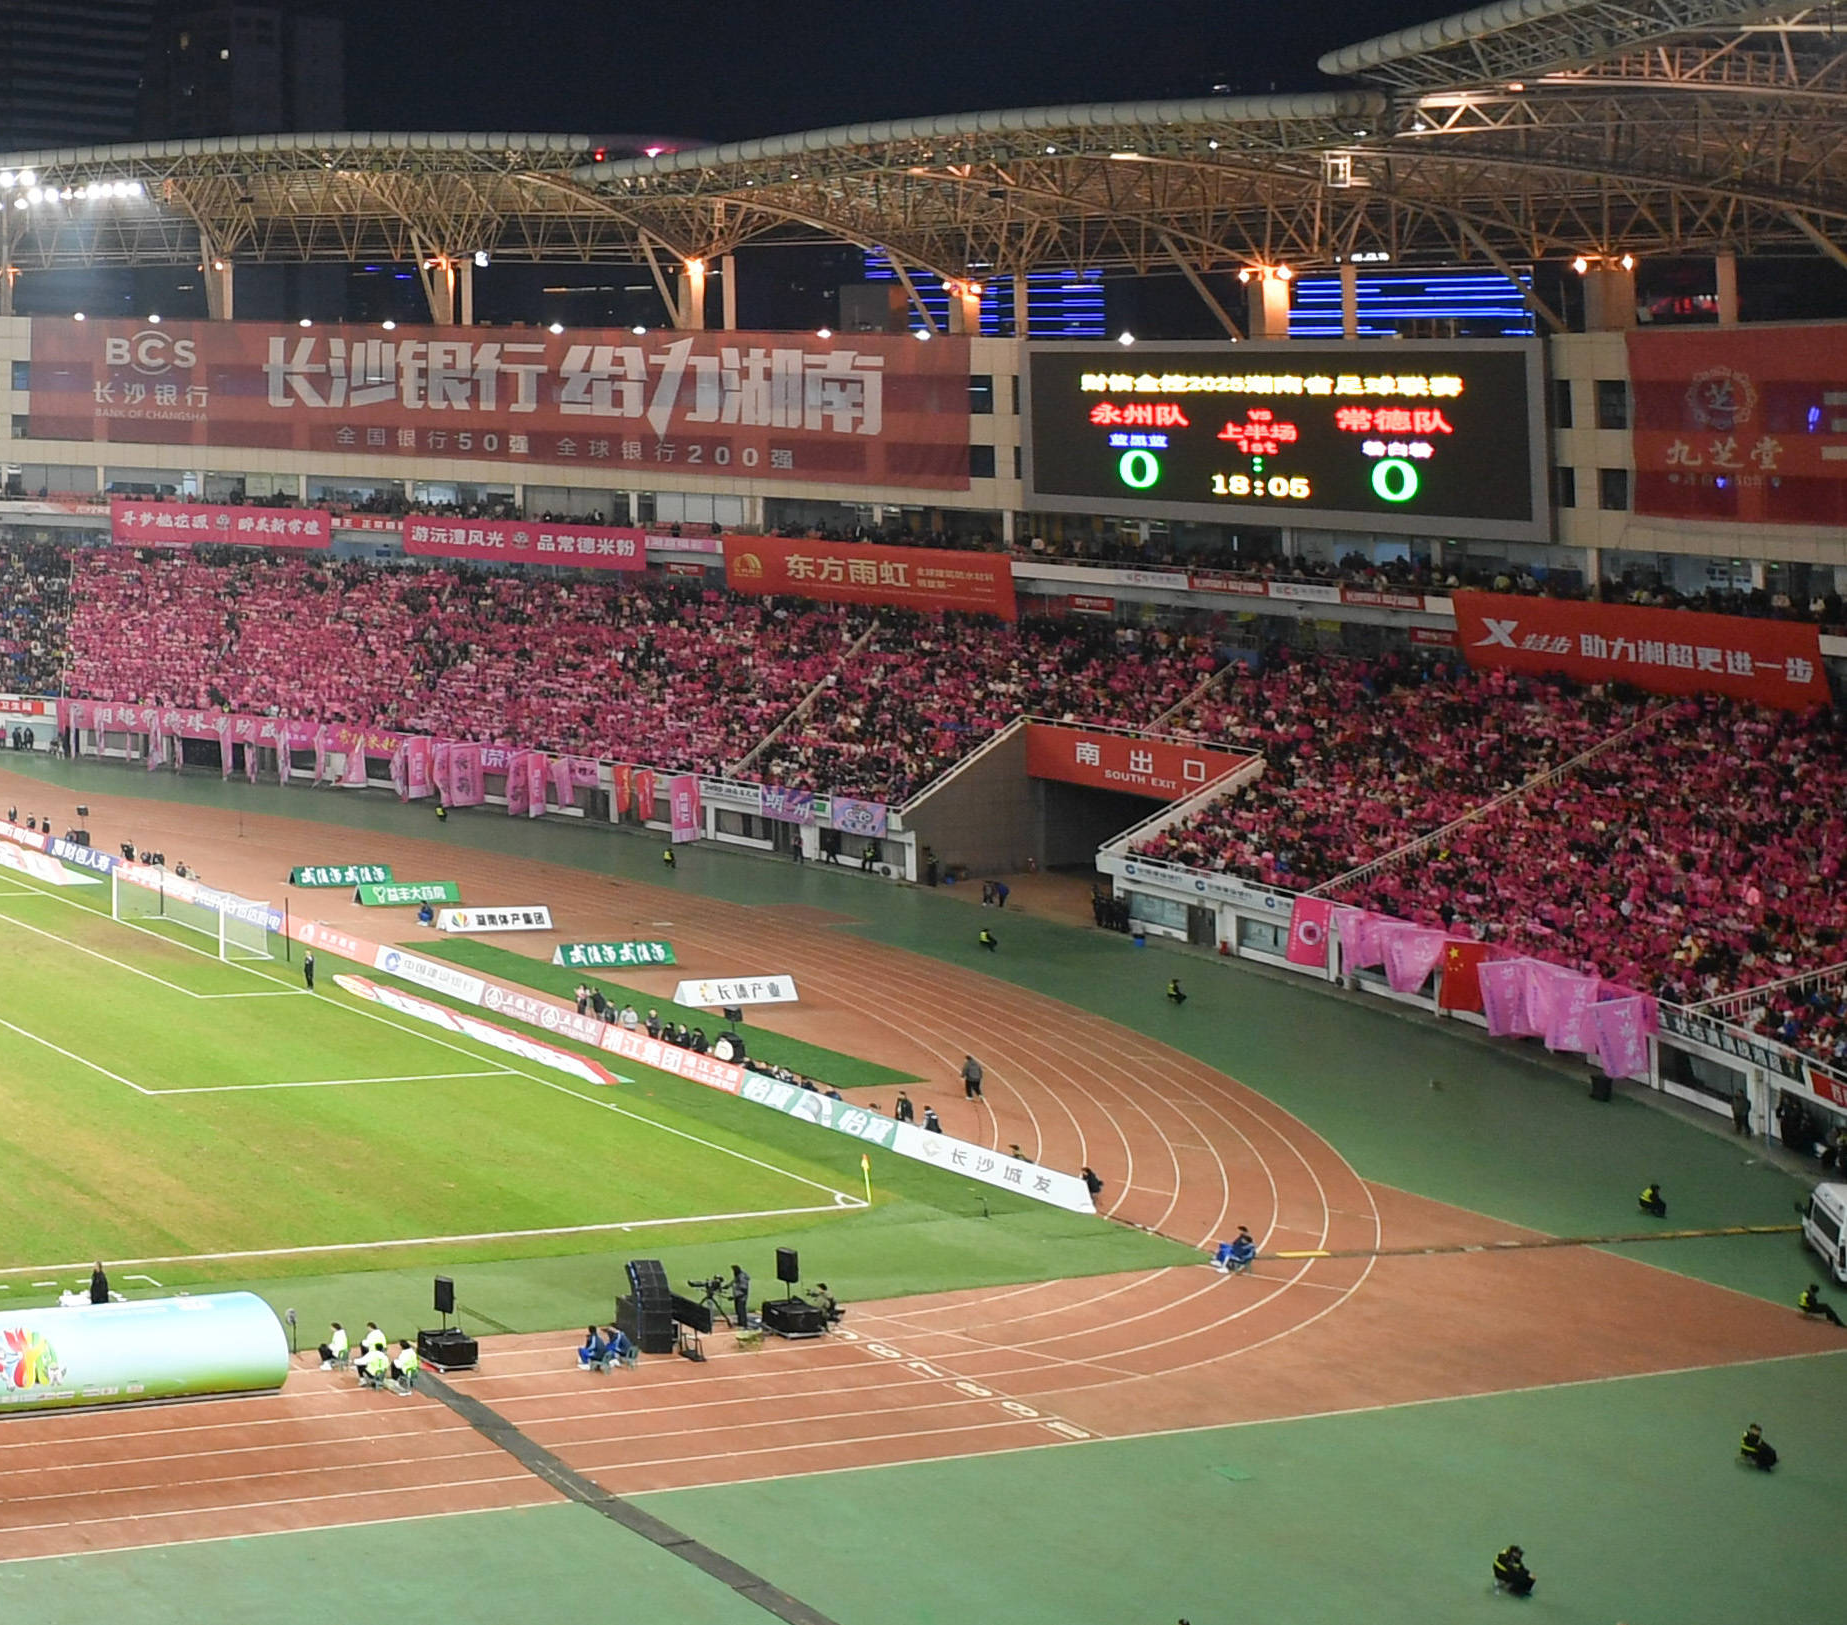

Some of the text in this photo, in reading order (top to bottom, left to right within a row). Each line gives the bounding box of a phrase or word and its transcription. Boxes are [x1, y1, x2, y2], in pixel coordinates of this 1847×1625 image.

[106, 337, 196, 368] BCS
[93, 381, 210, 408] 长沙银行
[263, 336, 884, 442] 长沙银行 给力湖南
[94, 408, 208, 422] BANK OF CHANGSHA
[1089, 401, 1189, 427] 永州队
[1335, 407, 1453, 434] 常德队
[337, 426, 793, 469] 全国银行50强 全球银行200强
[1217, 421, 1299, 443] 上半场
[1238, 439, 1278, 455] 1st
[1665, 436, 1784, 470] 九芝堂
[1119, 449, 1159, 488] 0
[1371, 458, 1418, 501] 0
[1211, 474, 1311, 498] 18:05
[411, 523, 636, 559] 游沅澧风光 品常德米粉
[784, 553, 911, 589] 东方雨虹
[1579, 633, 1814, 683] 助力湘超更进一步
[1075, 742, 1206, 783] 南出口
[1104, 769, 1177, 790] SOUTH EXIT
[603, 1028, 684, 1074] 湘江集团
